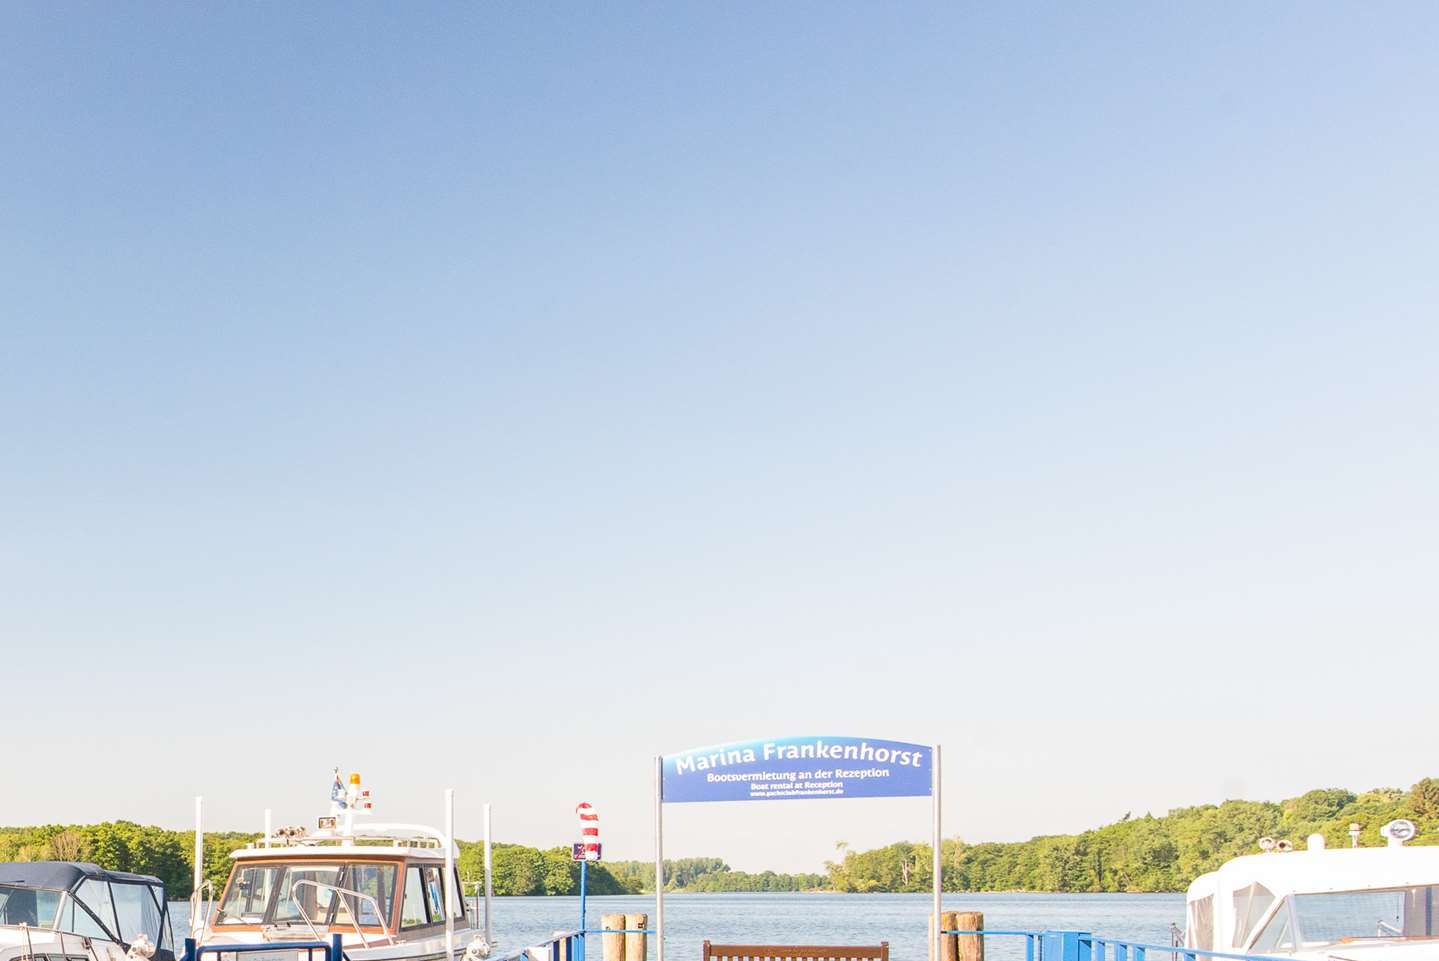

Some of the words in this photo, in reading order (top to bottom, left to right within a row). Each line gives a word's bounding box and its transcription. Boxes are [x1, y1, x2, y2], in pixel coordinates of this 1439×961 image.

[675, 747, 756, 775] Marina
[763, 740, 923, 767] Frankenhorst
[707, 771, 796, 782] Bootsvermietung
[798, 771, 812, 780] an
[814, 769, 833, 779] der
[835, 768, 890, 779] Rezeption
